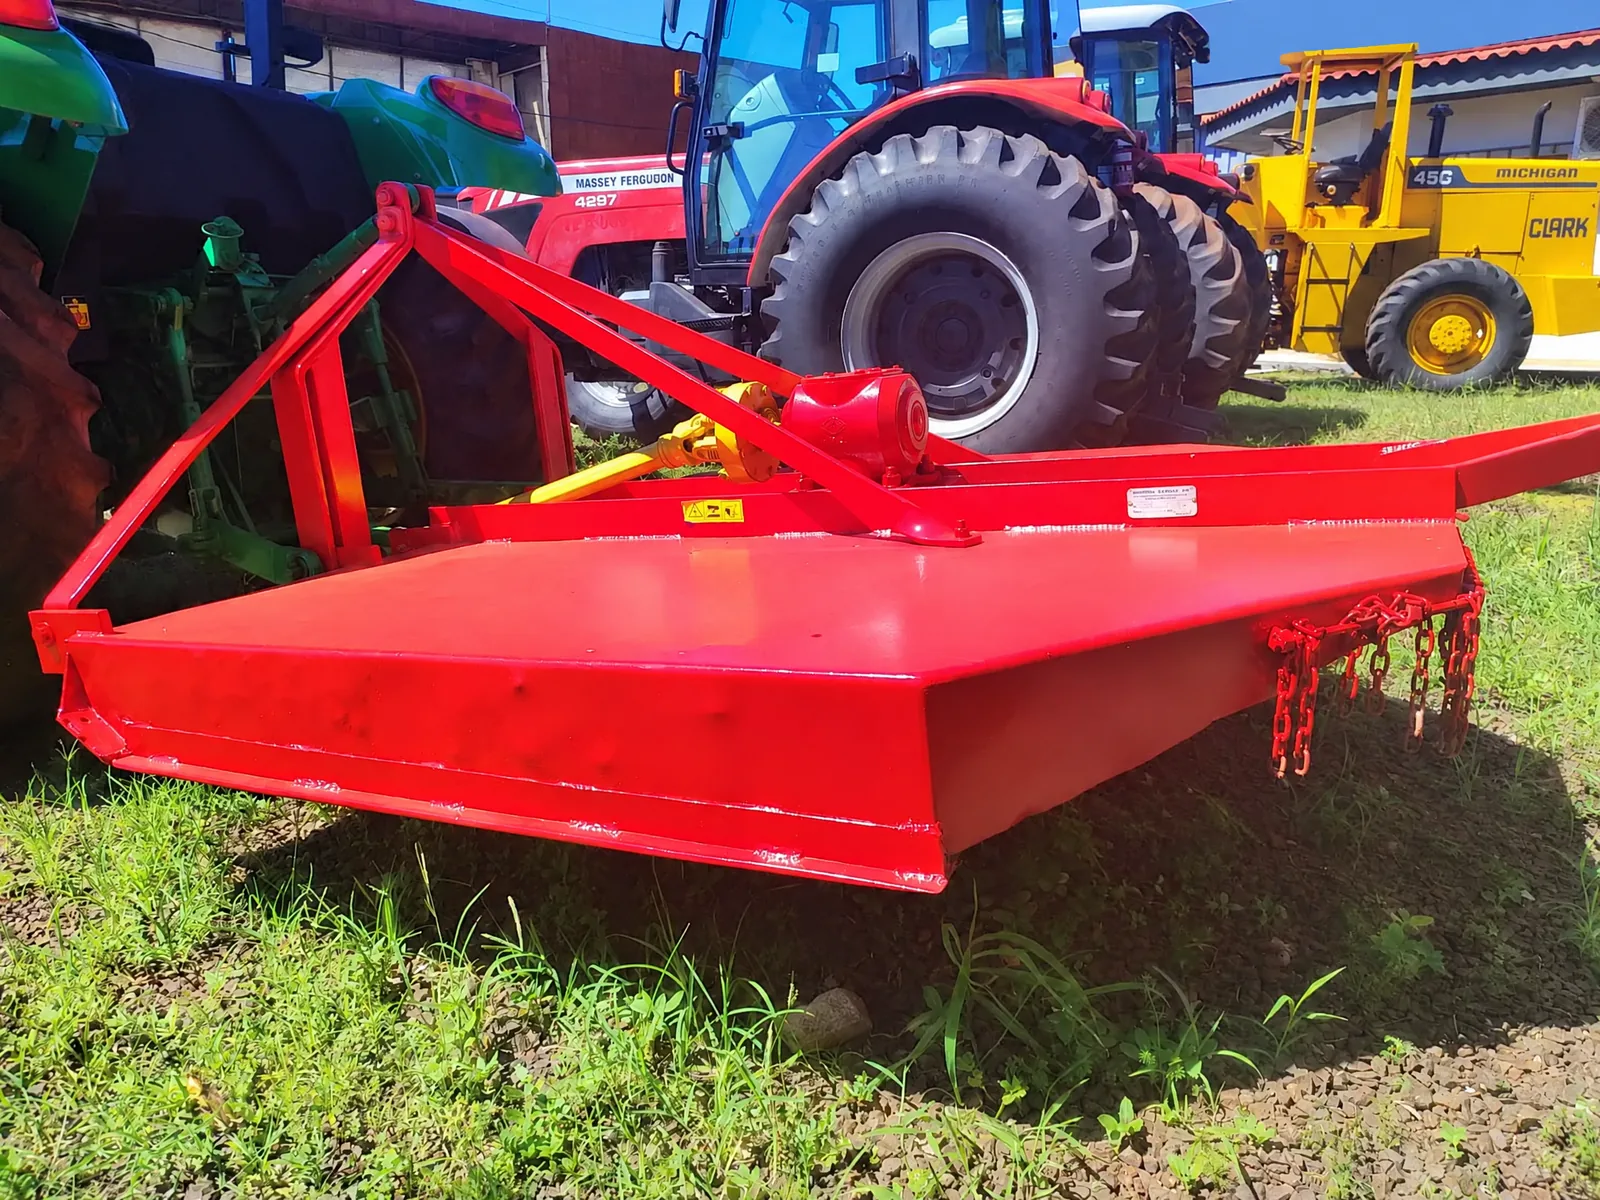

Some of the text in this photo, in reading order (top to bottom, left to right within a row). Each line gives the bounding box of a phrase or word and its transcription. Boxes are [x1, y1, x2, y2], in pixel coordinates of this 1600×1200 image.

[1496, 168, 1578, 178] MICHIGAN
[576, 177, 617, 188] MASSEY
[575, 194, 617, 208] 4297
[1529, 217, 1589, 238] CLARK
